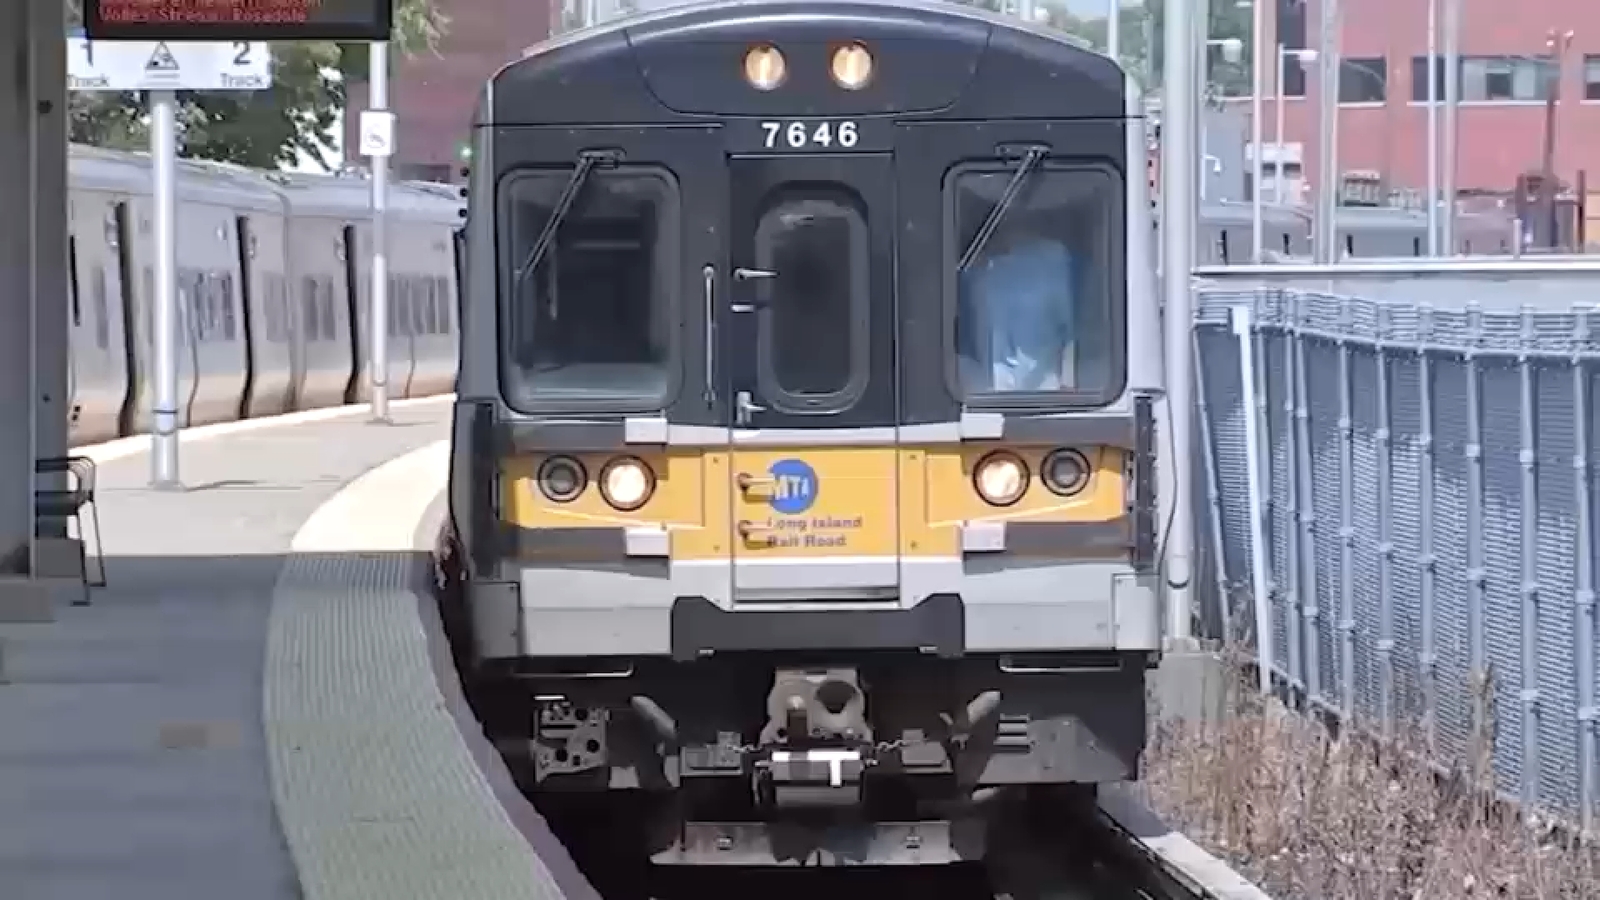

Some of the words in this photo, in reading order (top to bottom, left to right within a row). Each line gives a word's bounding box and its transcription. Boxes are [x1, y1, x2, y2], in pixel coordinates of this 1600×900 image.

[80, 40, 93, 67] 1
[232, 41, 252, 65] 2
[219, 72, 262, 88] Track
[761, 121, 859, 148] 7646
[771, 474, 810, 500] MTA
[812, 516, 863, 528] Island
[804, 534, 847, 547] Road
